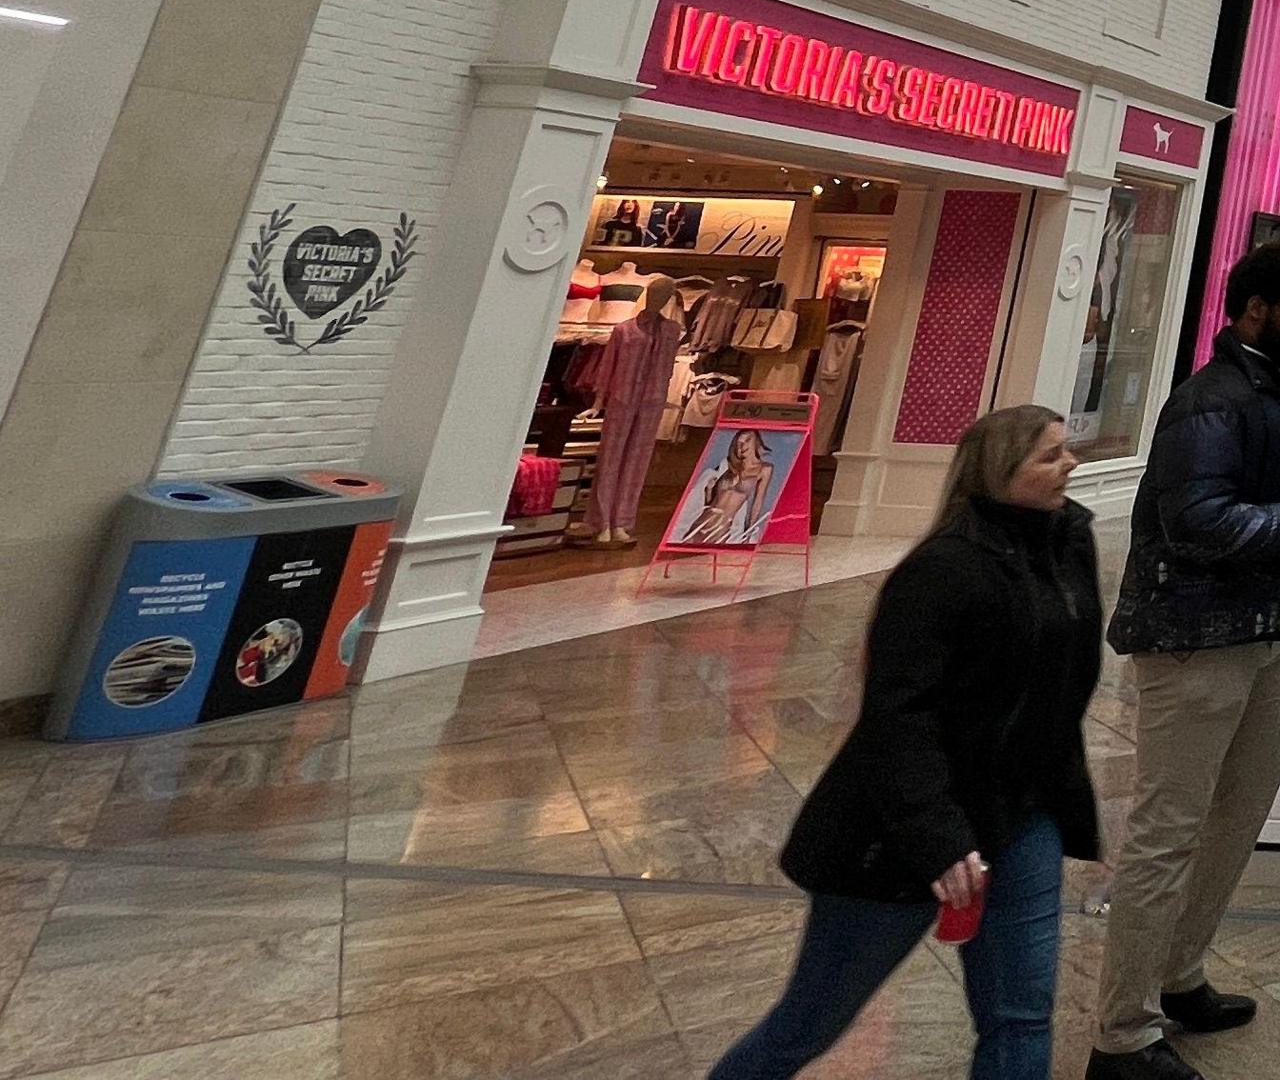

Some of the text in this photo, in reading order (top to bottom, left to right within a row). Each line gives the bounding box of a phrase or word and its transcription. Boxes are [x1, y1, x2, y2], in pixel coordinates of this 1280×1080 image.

[670, 5, 1076, 154] VICTORIA'S SECRET PINK
[296, 242, 375, 264] VICTORIA'S
[301, 264, 356, 283] SECRET
